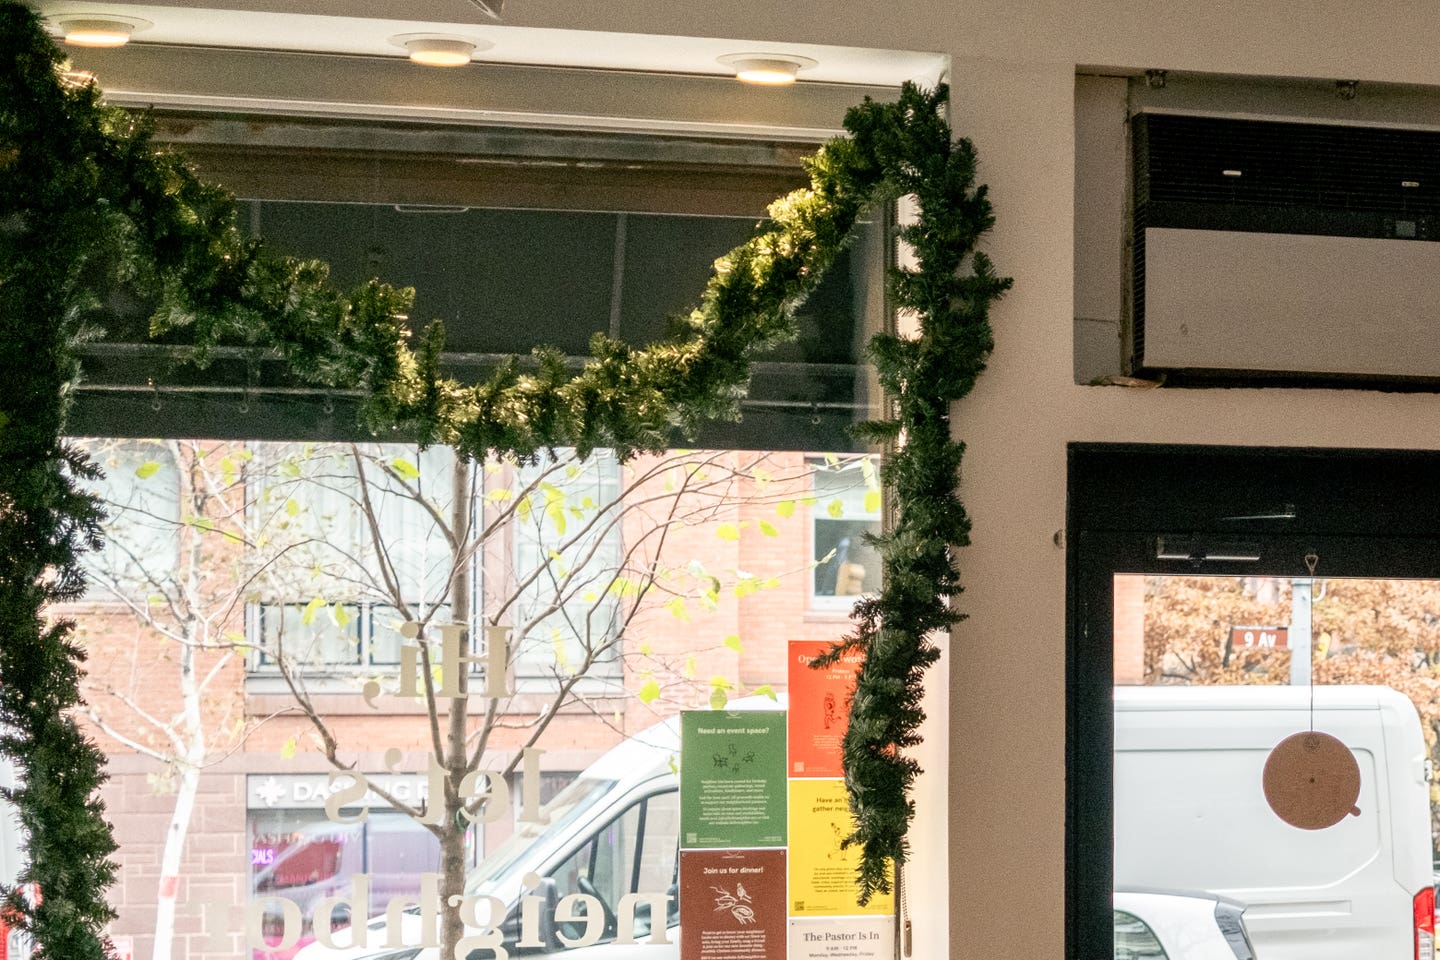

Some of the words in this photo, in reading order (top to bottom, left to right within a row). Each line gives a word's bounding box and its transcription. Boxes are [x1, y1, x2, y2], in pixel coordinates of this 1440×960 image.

[1244, 631, 1254, 648] 9
[1257, 631, 1277, 648] Av
[697, 727, 715, 735] Need
[746, 727, 770, 736] space?
[812, 805, 833, 813] gather
[703, 867, 718, 875] Join
[740, 866, 764, 874] dinner!
[803, 932, 823, 942] The
[825, 932, 856, 942] Pastor
[858, 932, 868, 941] Is
[869, 931, 880, 940] In
